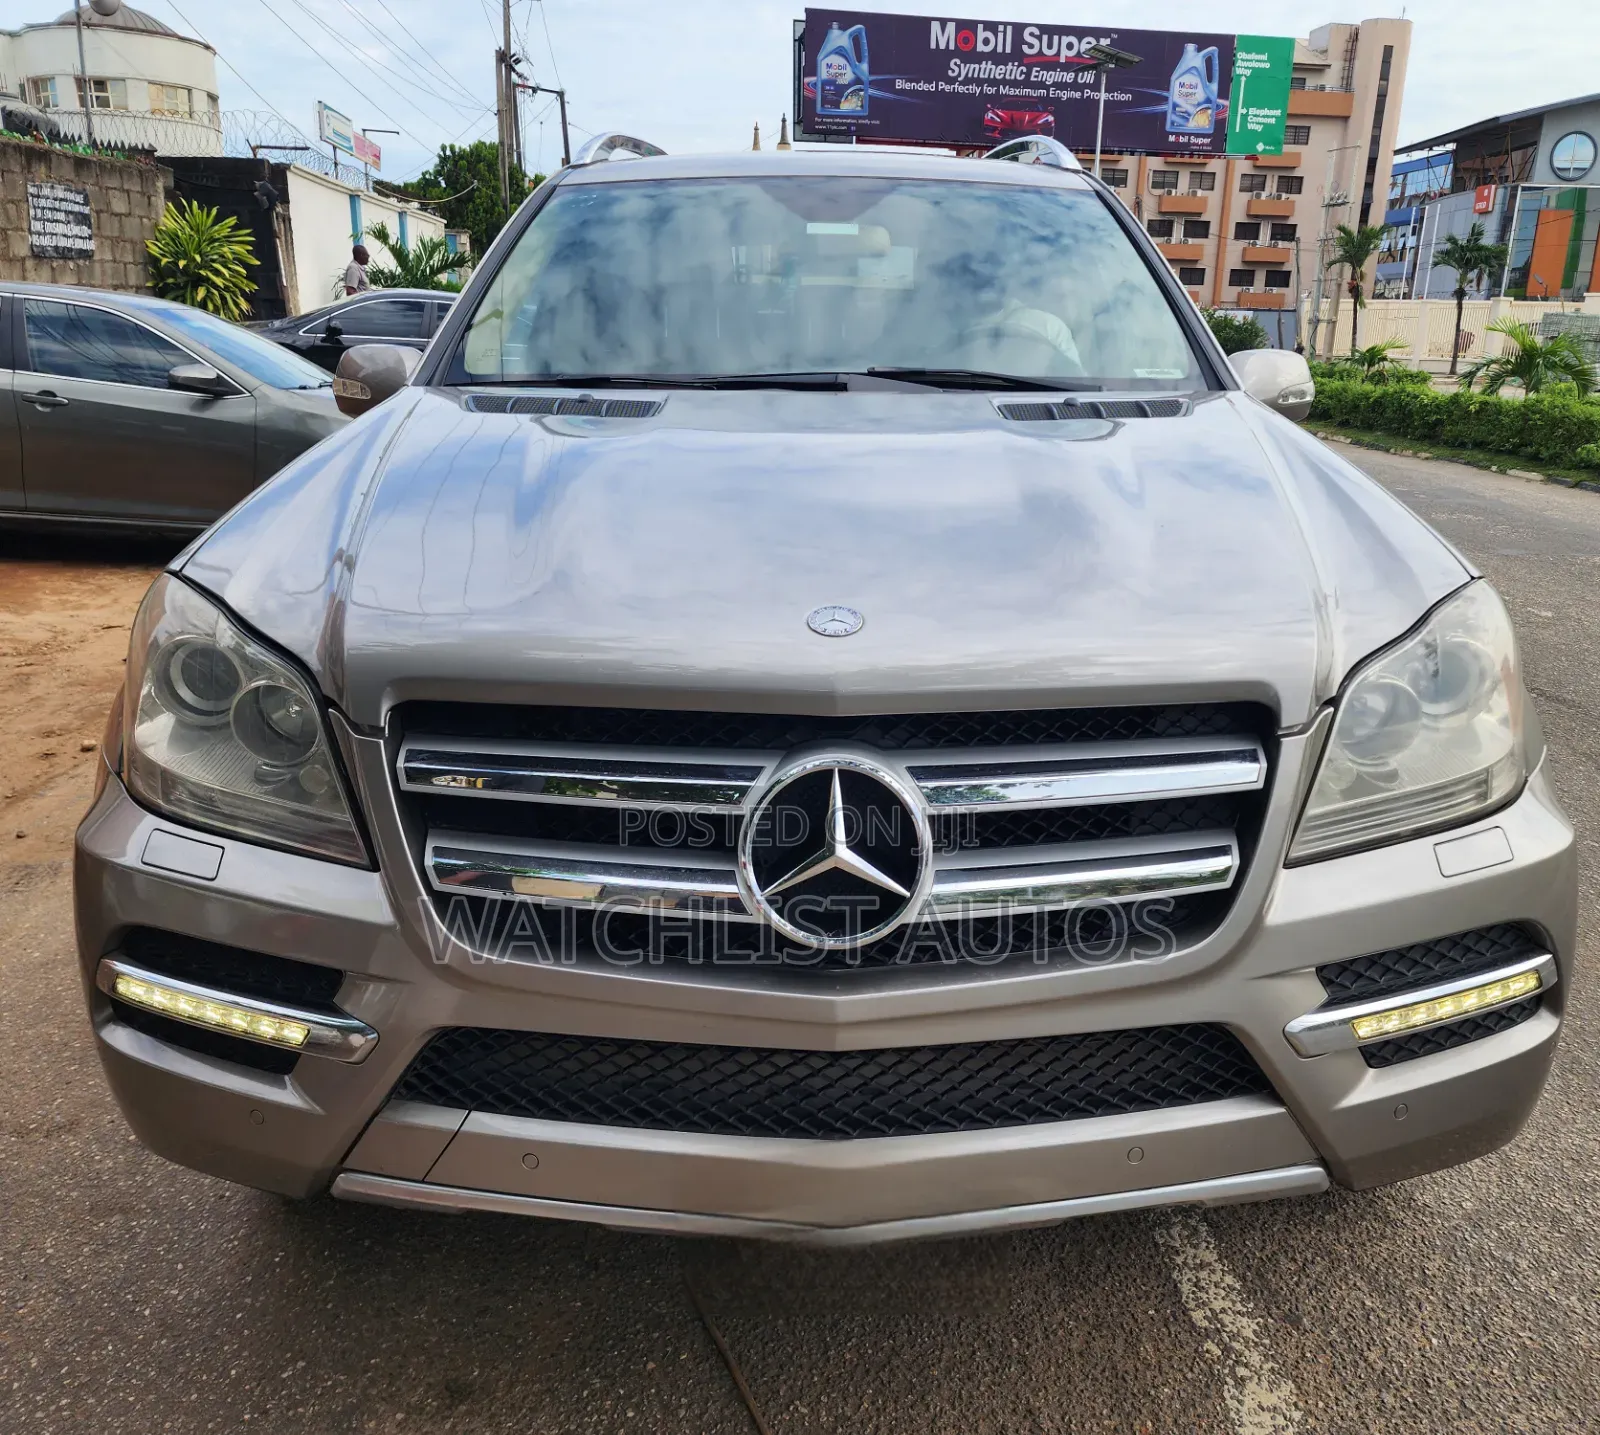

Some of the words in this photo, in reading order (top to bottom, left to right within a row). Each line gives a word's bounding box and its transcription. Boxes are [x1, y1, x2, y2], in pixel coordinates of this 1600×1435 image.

[930, 20, 1013, 53] Mobil
[1237, 52, 1268, 61] Obafemi
[826, 63, 847, 71] Mobil
[1236, 60, 1270, 69] Awolowo
[826, 71, 847, 79] Super
[948, 58, 1026, 81] Synthetic
[1030, 67, 1075, 84] Engine
[1077, 70, 1096, 84] Oil
[1235, 67, 1252, 76] Way
[895, 79, 936, 91] Blended
[938, 81, 981, 96] Perfectly
[983, 84, 997, 94] for
[999, 85, 1047, 98] Maximum
[1049, 87, 1082, 101] Engine
[1083, 89, 1132, 101] Proection
[1178, 82, 1198, 90] Mobil
[1178, 90, 1197, 98] Super
[1248, 107, 1281, 116] Elephant
[1247, 115, 1276, 124] Cement
[1247, 123, 1264, 132] Way
[1168, 134, 1189, 143] Mobil
[1190, 136, 1212, 145] Super
